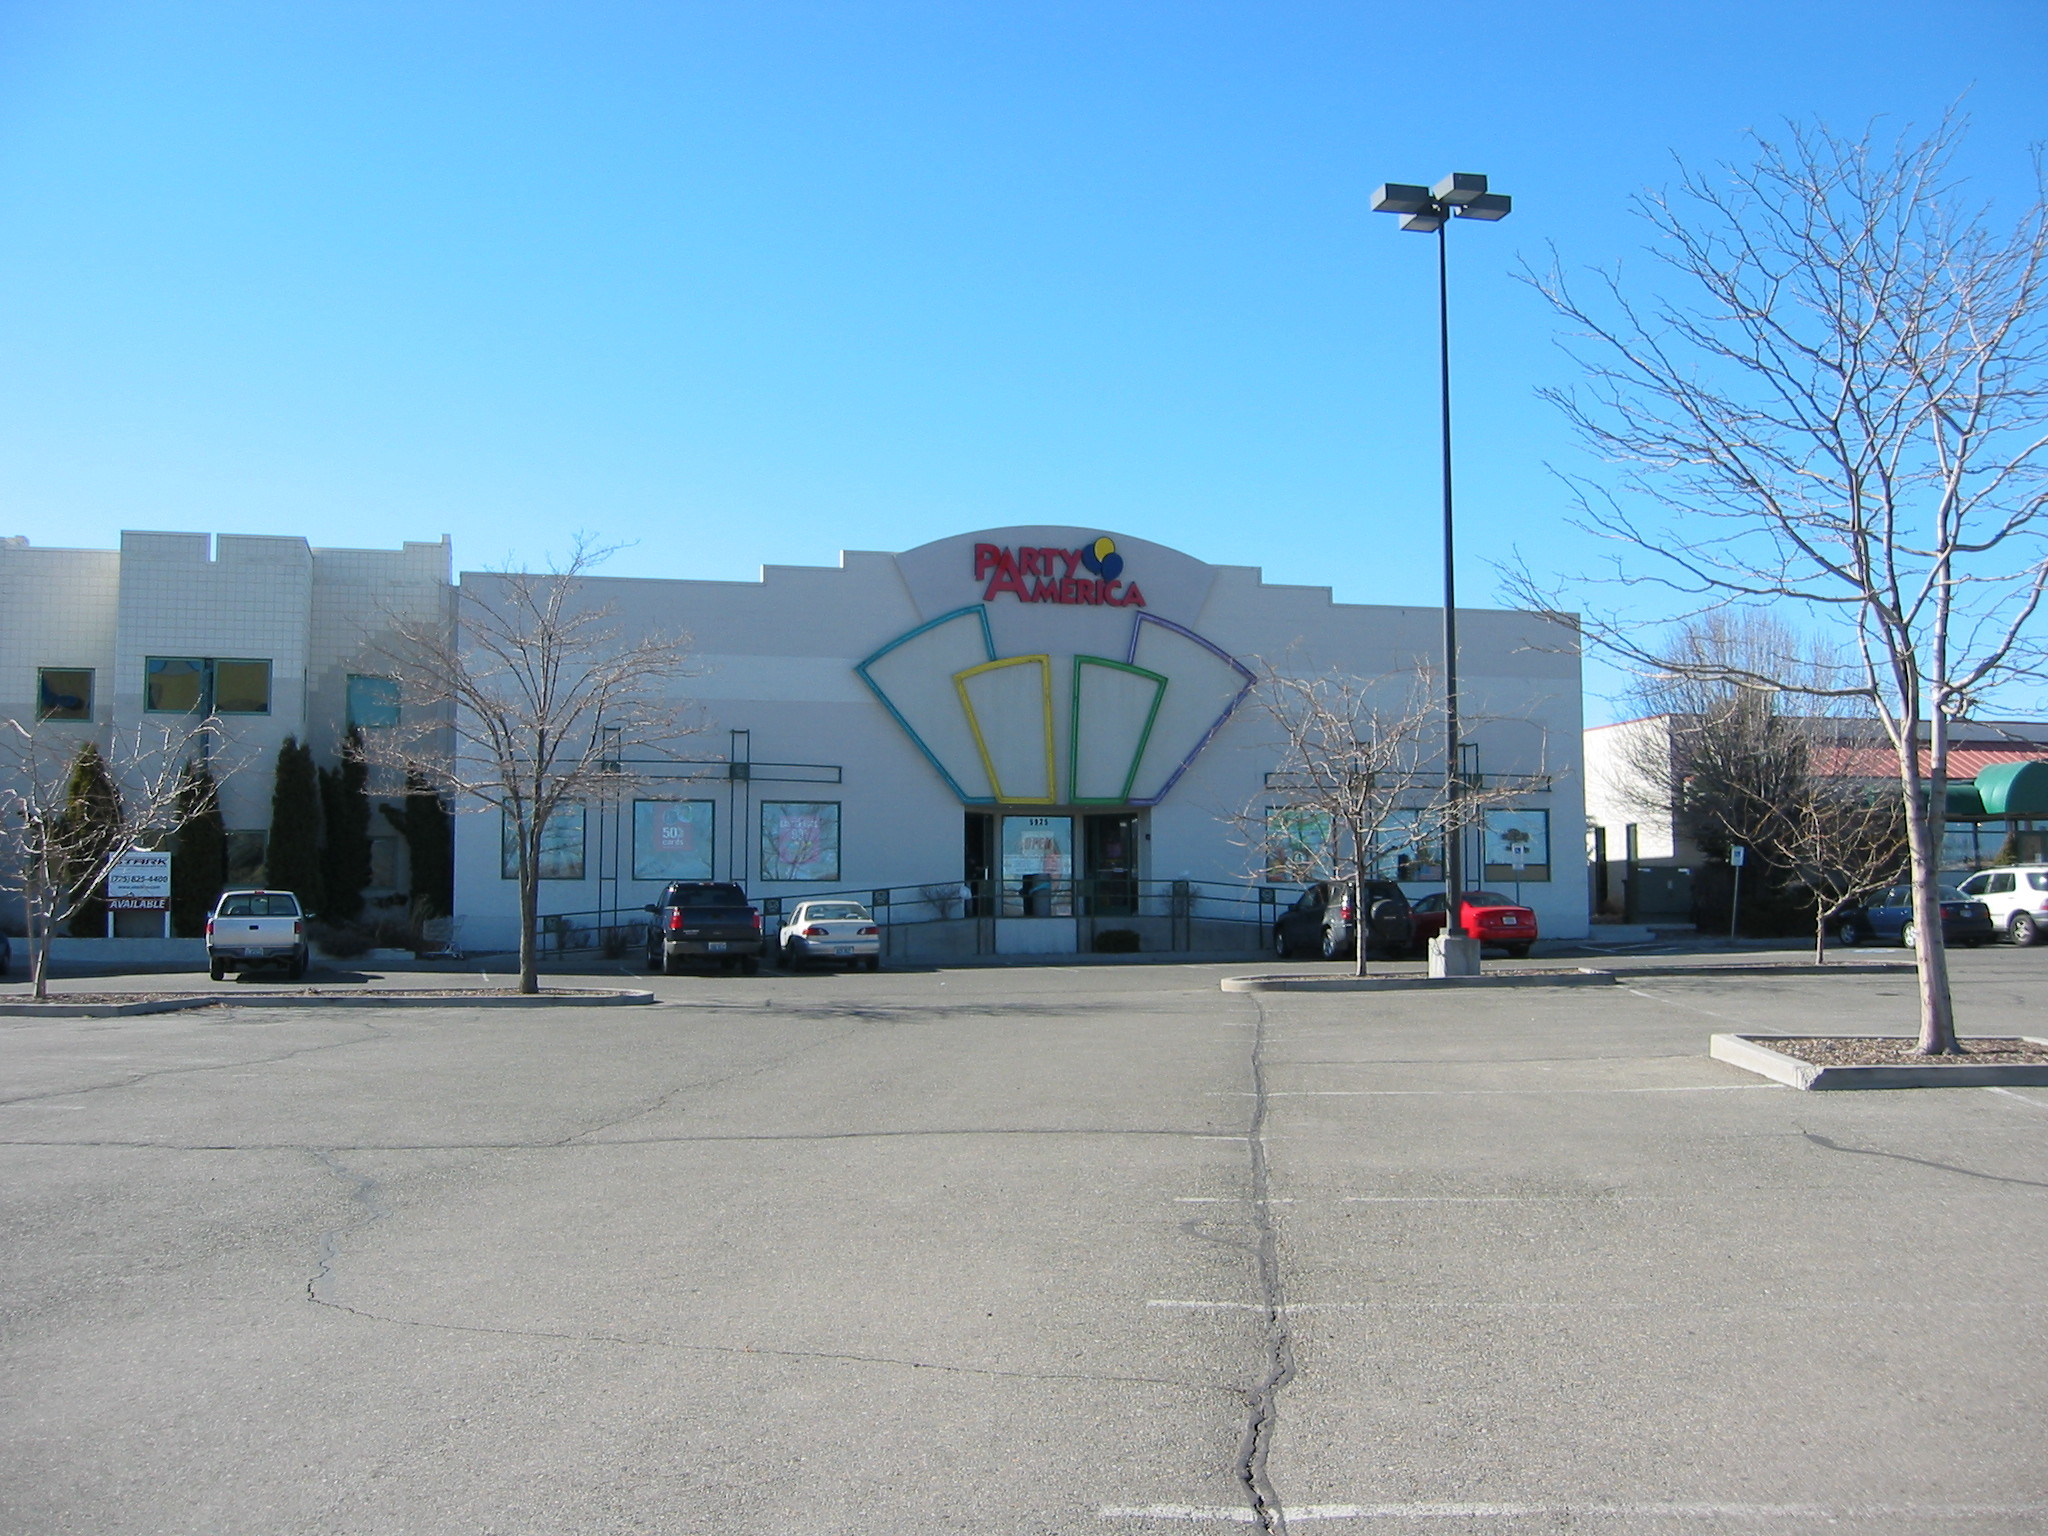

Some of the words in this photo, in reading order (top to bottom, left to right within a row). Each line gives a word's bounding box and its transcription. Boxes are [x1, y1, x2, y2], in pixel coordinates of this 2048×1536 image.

[974, 543, 1083, 593] PARTY
[982, 553, 1147, 607] AMERICA
[110, 900, 165, 908] AVAILABLE
